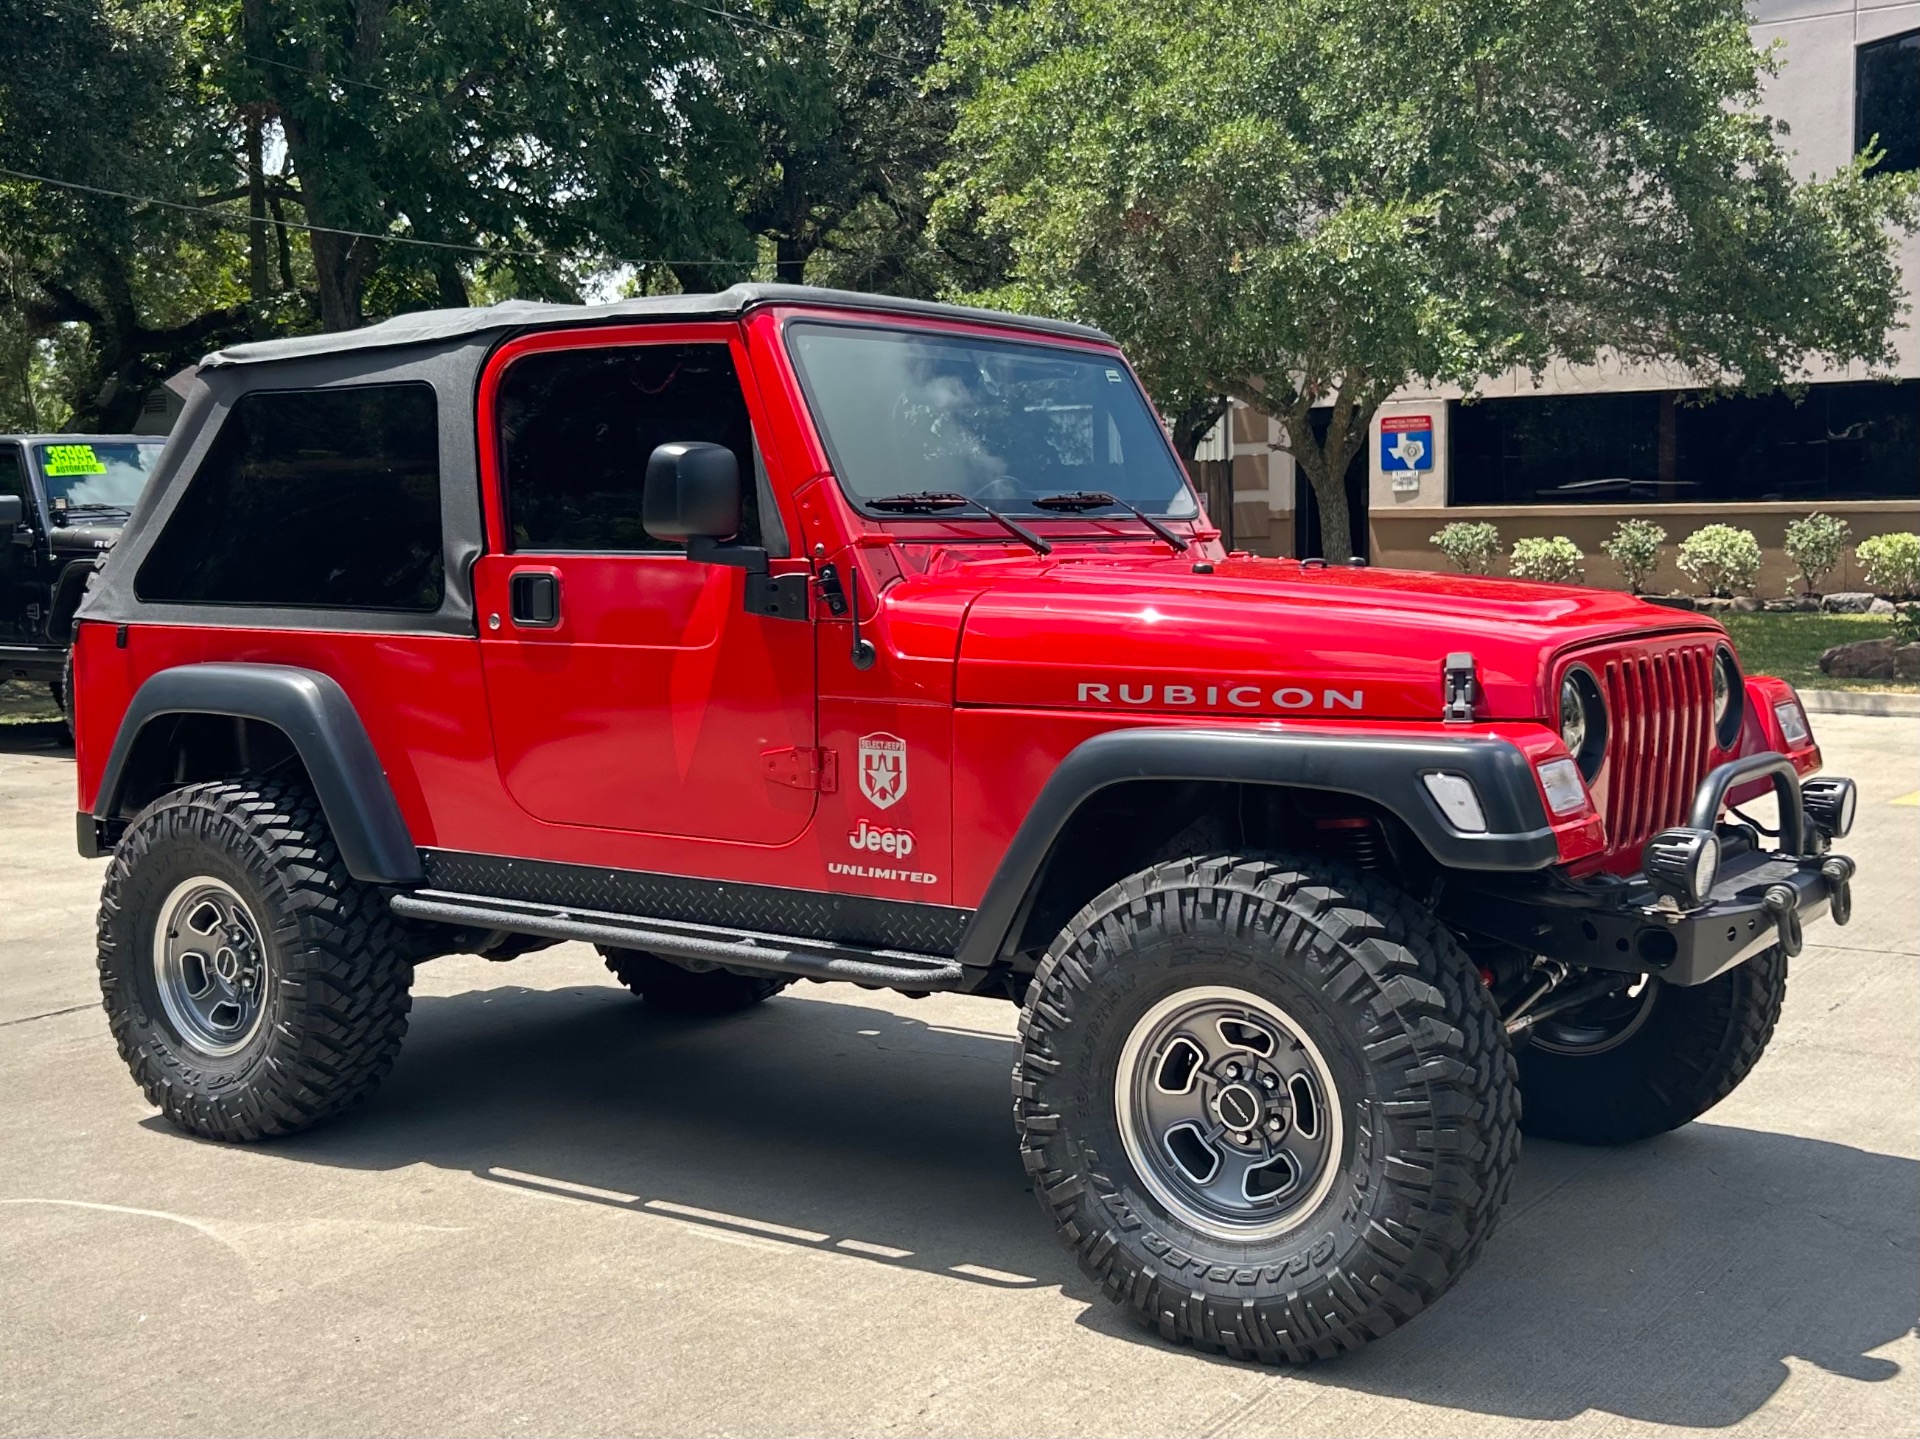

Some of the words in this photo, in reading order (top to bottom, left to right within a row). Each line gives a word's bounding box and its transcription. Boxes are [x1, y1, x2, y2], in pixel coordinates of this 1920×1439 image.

[46, 445, 97, 465] 35995
[55, 465, 97, 474] AUTOMATIC
[1077, 683, 1364, 710] RUBICON
[848, 821, 914, 860] Jeep
[828, 862, 938, 885] UNLIMITED
[1140, 1231, 1336, 1287] GRAPPLER
